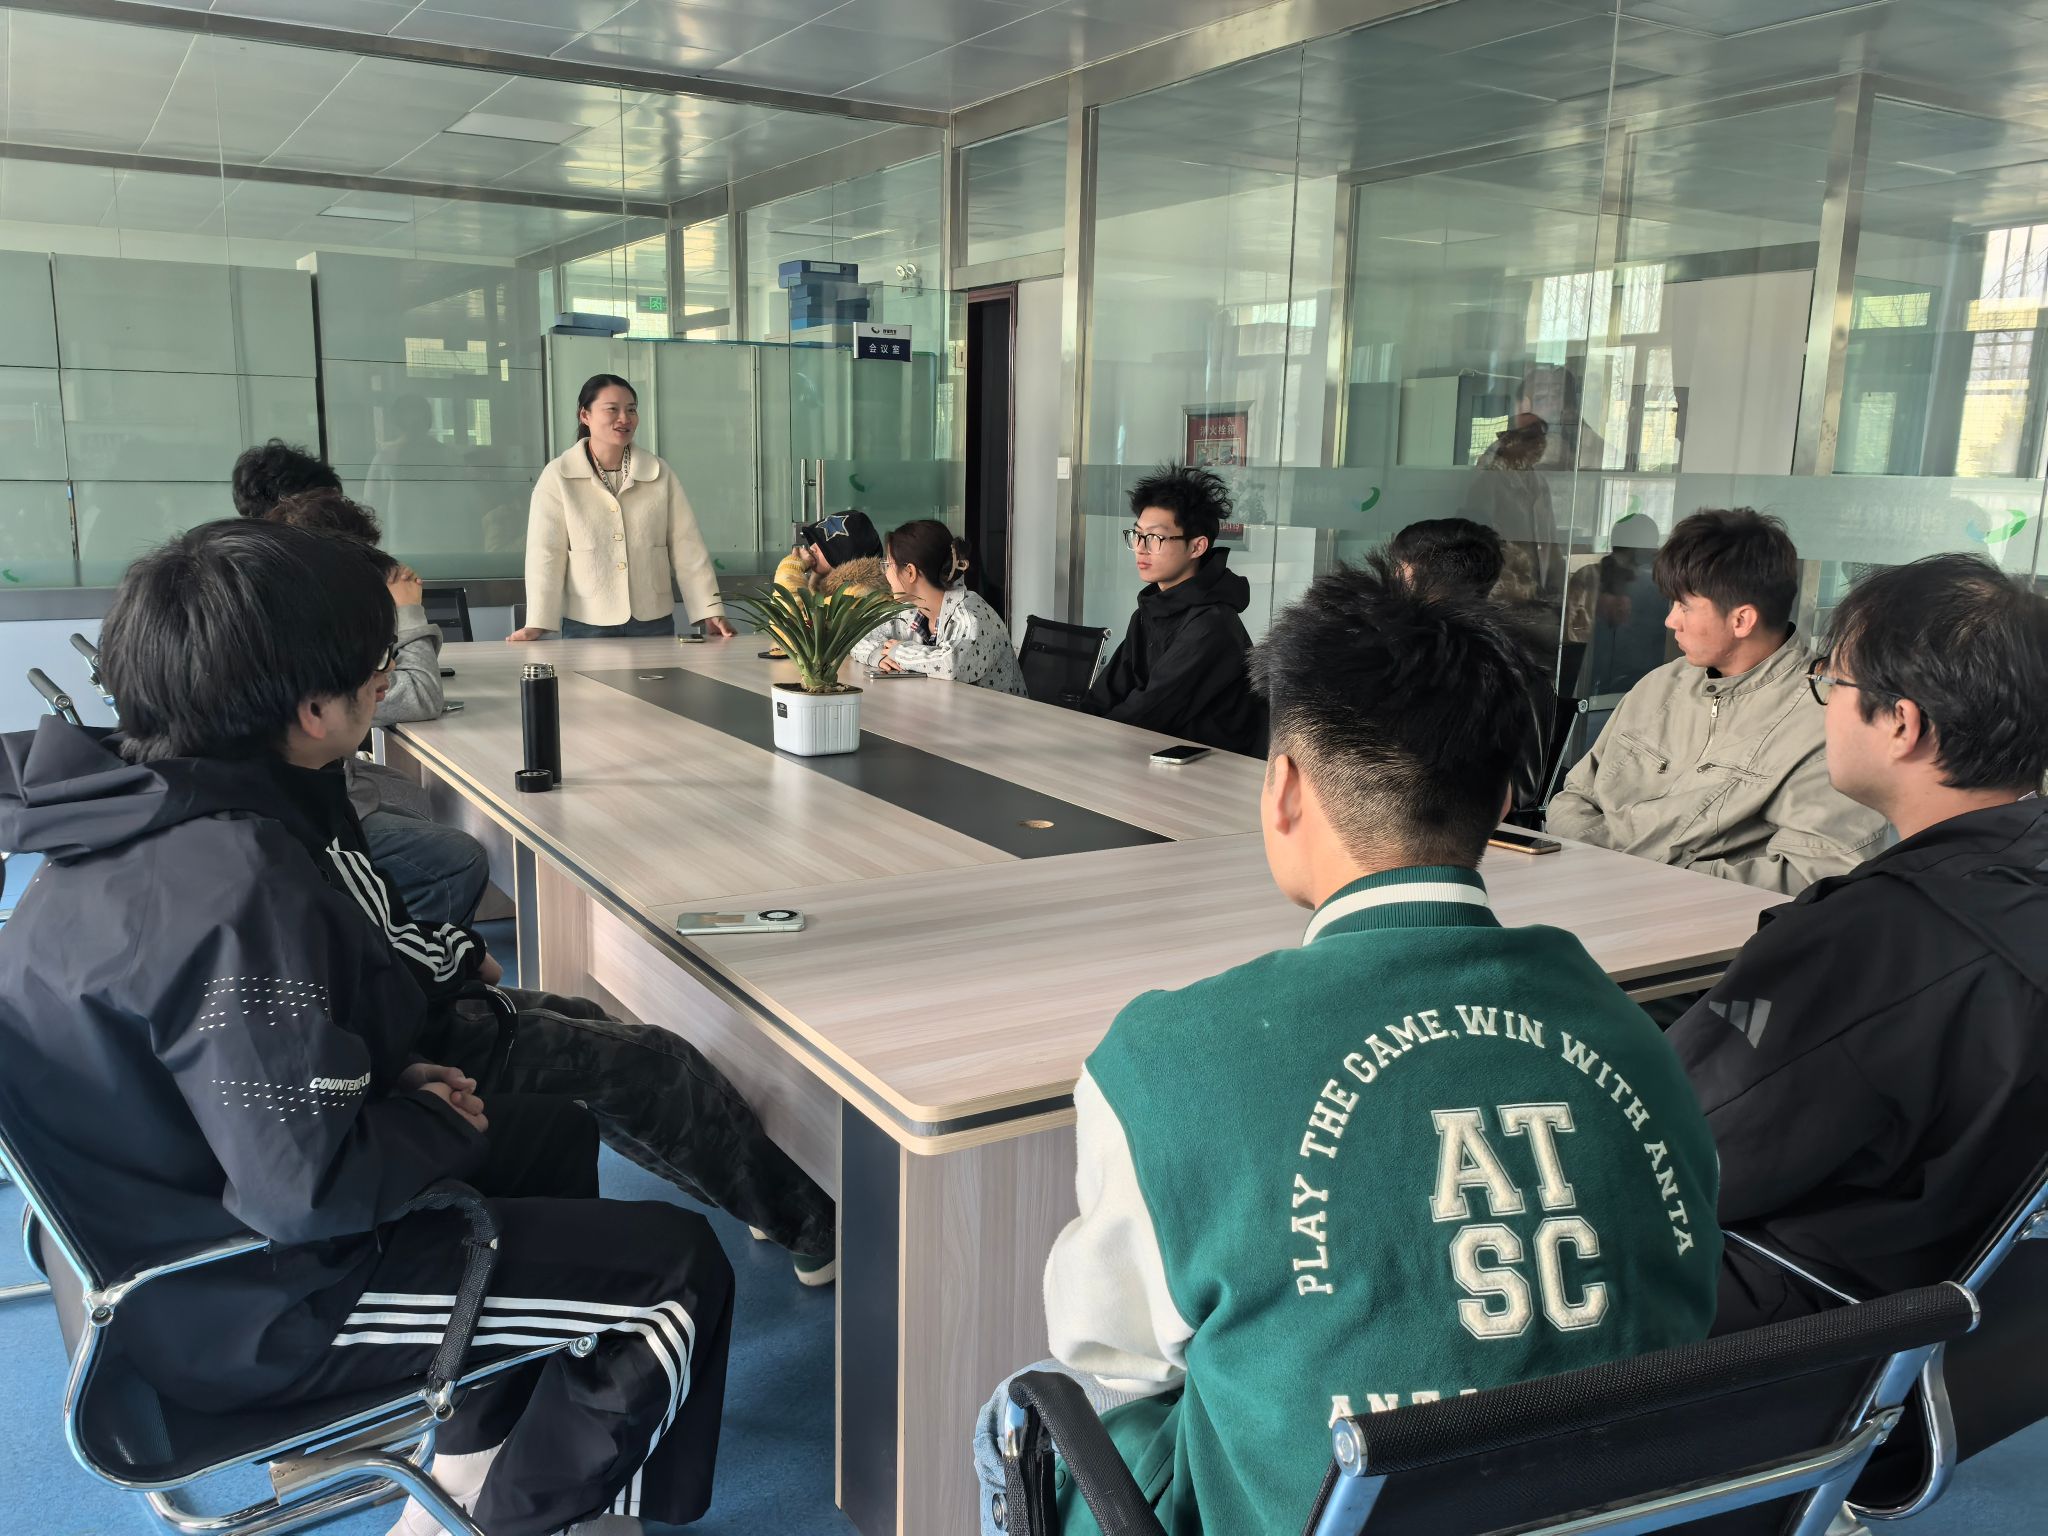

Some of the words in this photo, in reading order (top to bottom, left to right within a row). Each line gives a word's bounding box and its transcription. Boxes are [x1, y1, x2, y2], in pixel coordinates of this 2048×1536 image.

[869, 343, 900, 355] 会议室
[1300, 1078, 1360, 1159] THE
[1560, 1031, 1650, 1132] WITH
[1428, 1102, 1576, 1222] AT
[1643, 1140, 1695, 1257] ANTA
[1291, 1173, 1334, 1295] PLAY
[1449, 1216, 1609, 1340] SC
